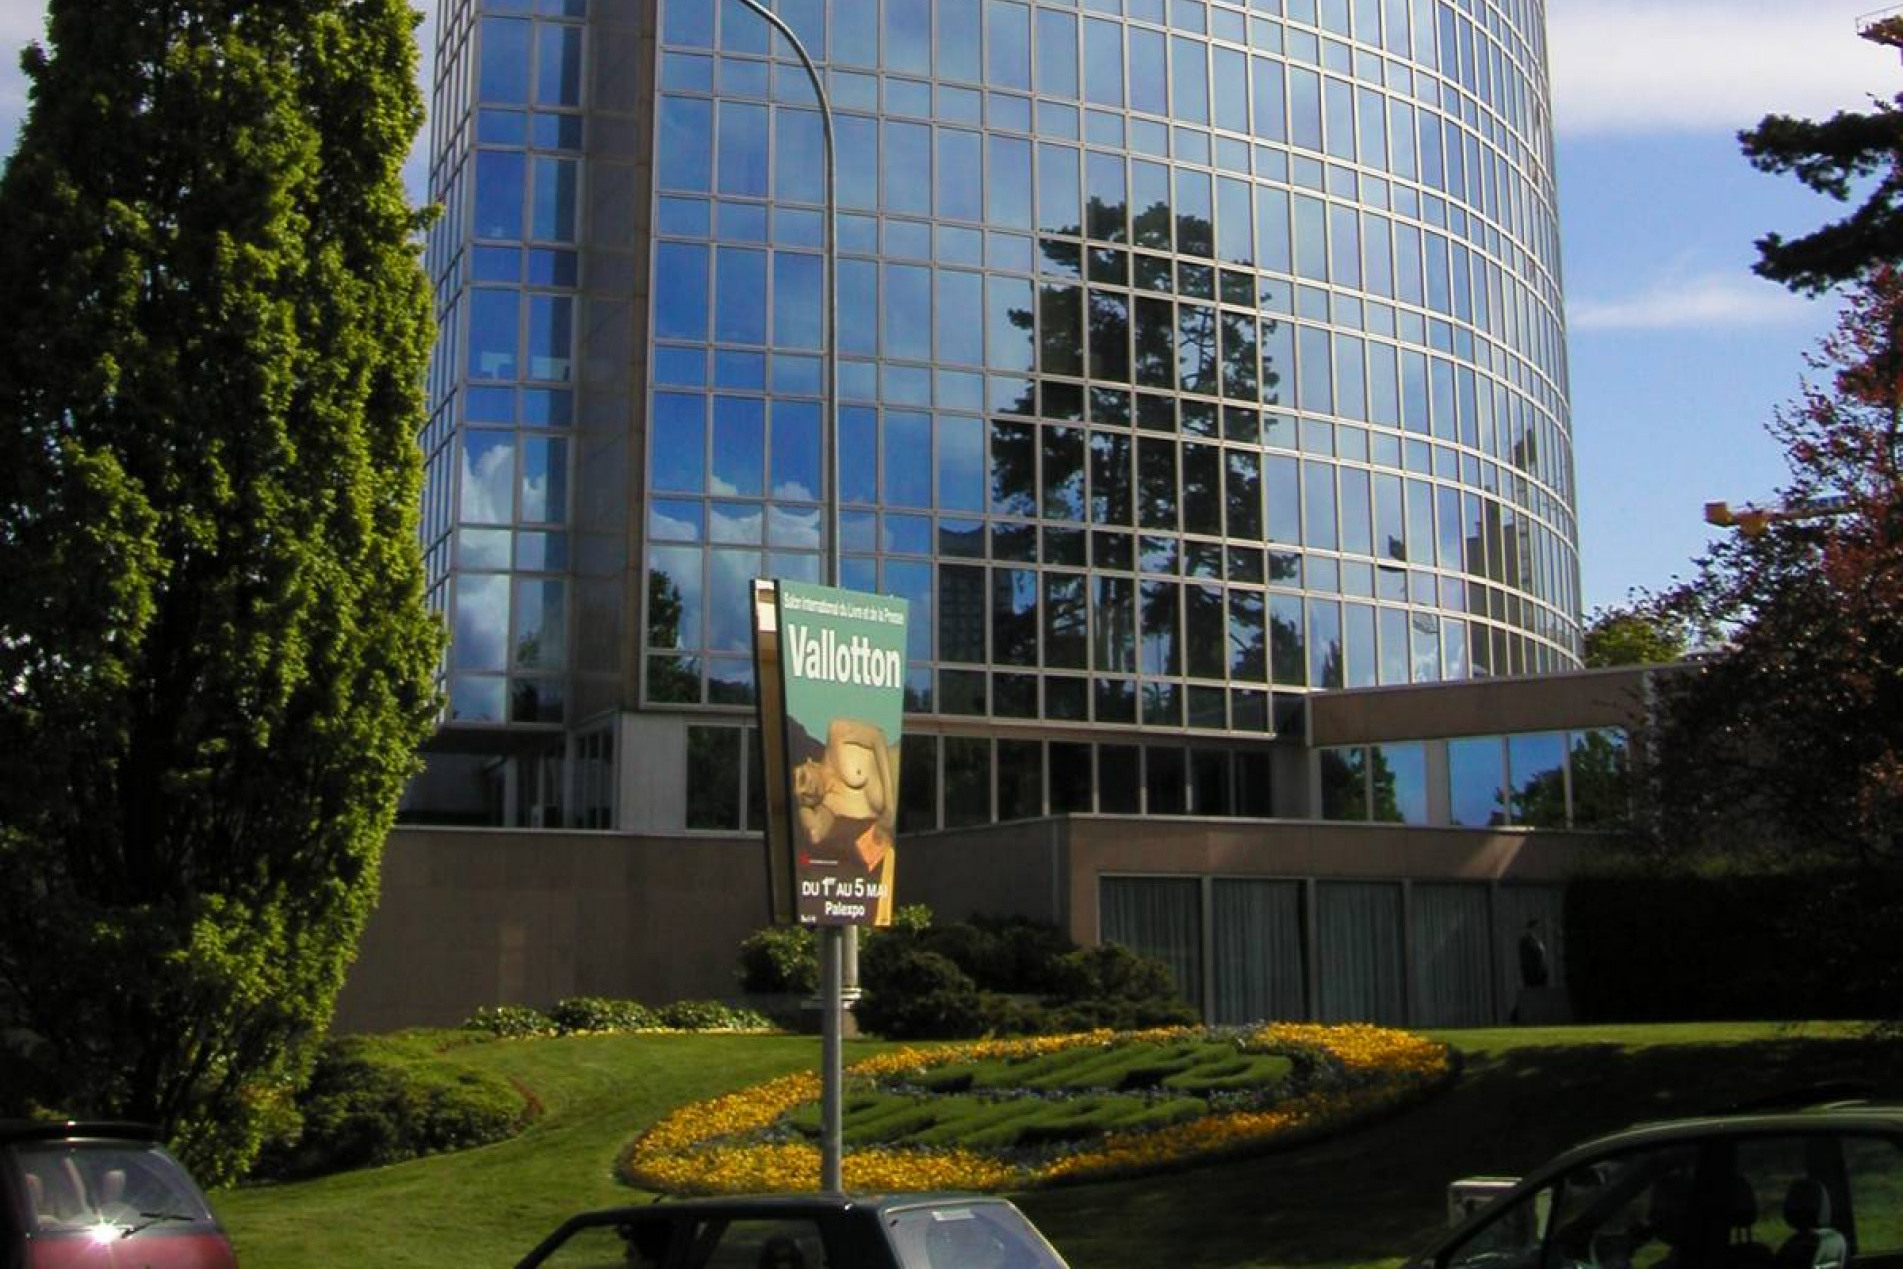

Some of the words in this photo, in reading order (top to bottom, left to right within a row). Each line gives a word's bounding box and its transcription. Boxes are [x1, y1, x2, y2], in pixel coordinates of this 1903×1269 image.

[787, 623, 901, 688] Vallotton
[802, 881, 819, 896] DU
[836, 882, 853, 897] AU
[855, 878, 864, 897] 5
[825, 900, 865, 919] Palexpo
